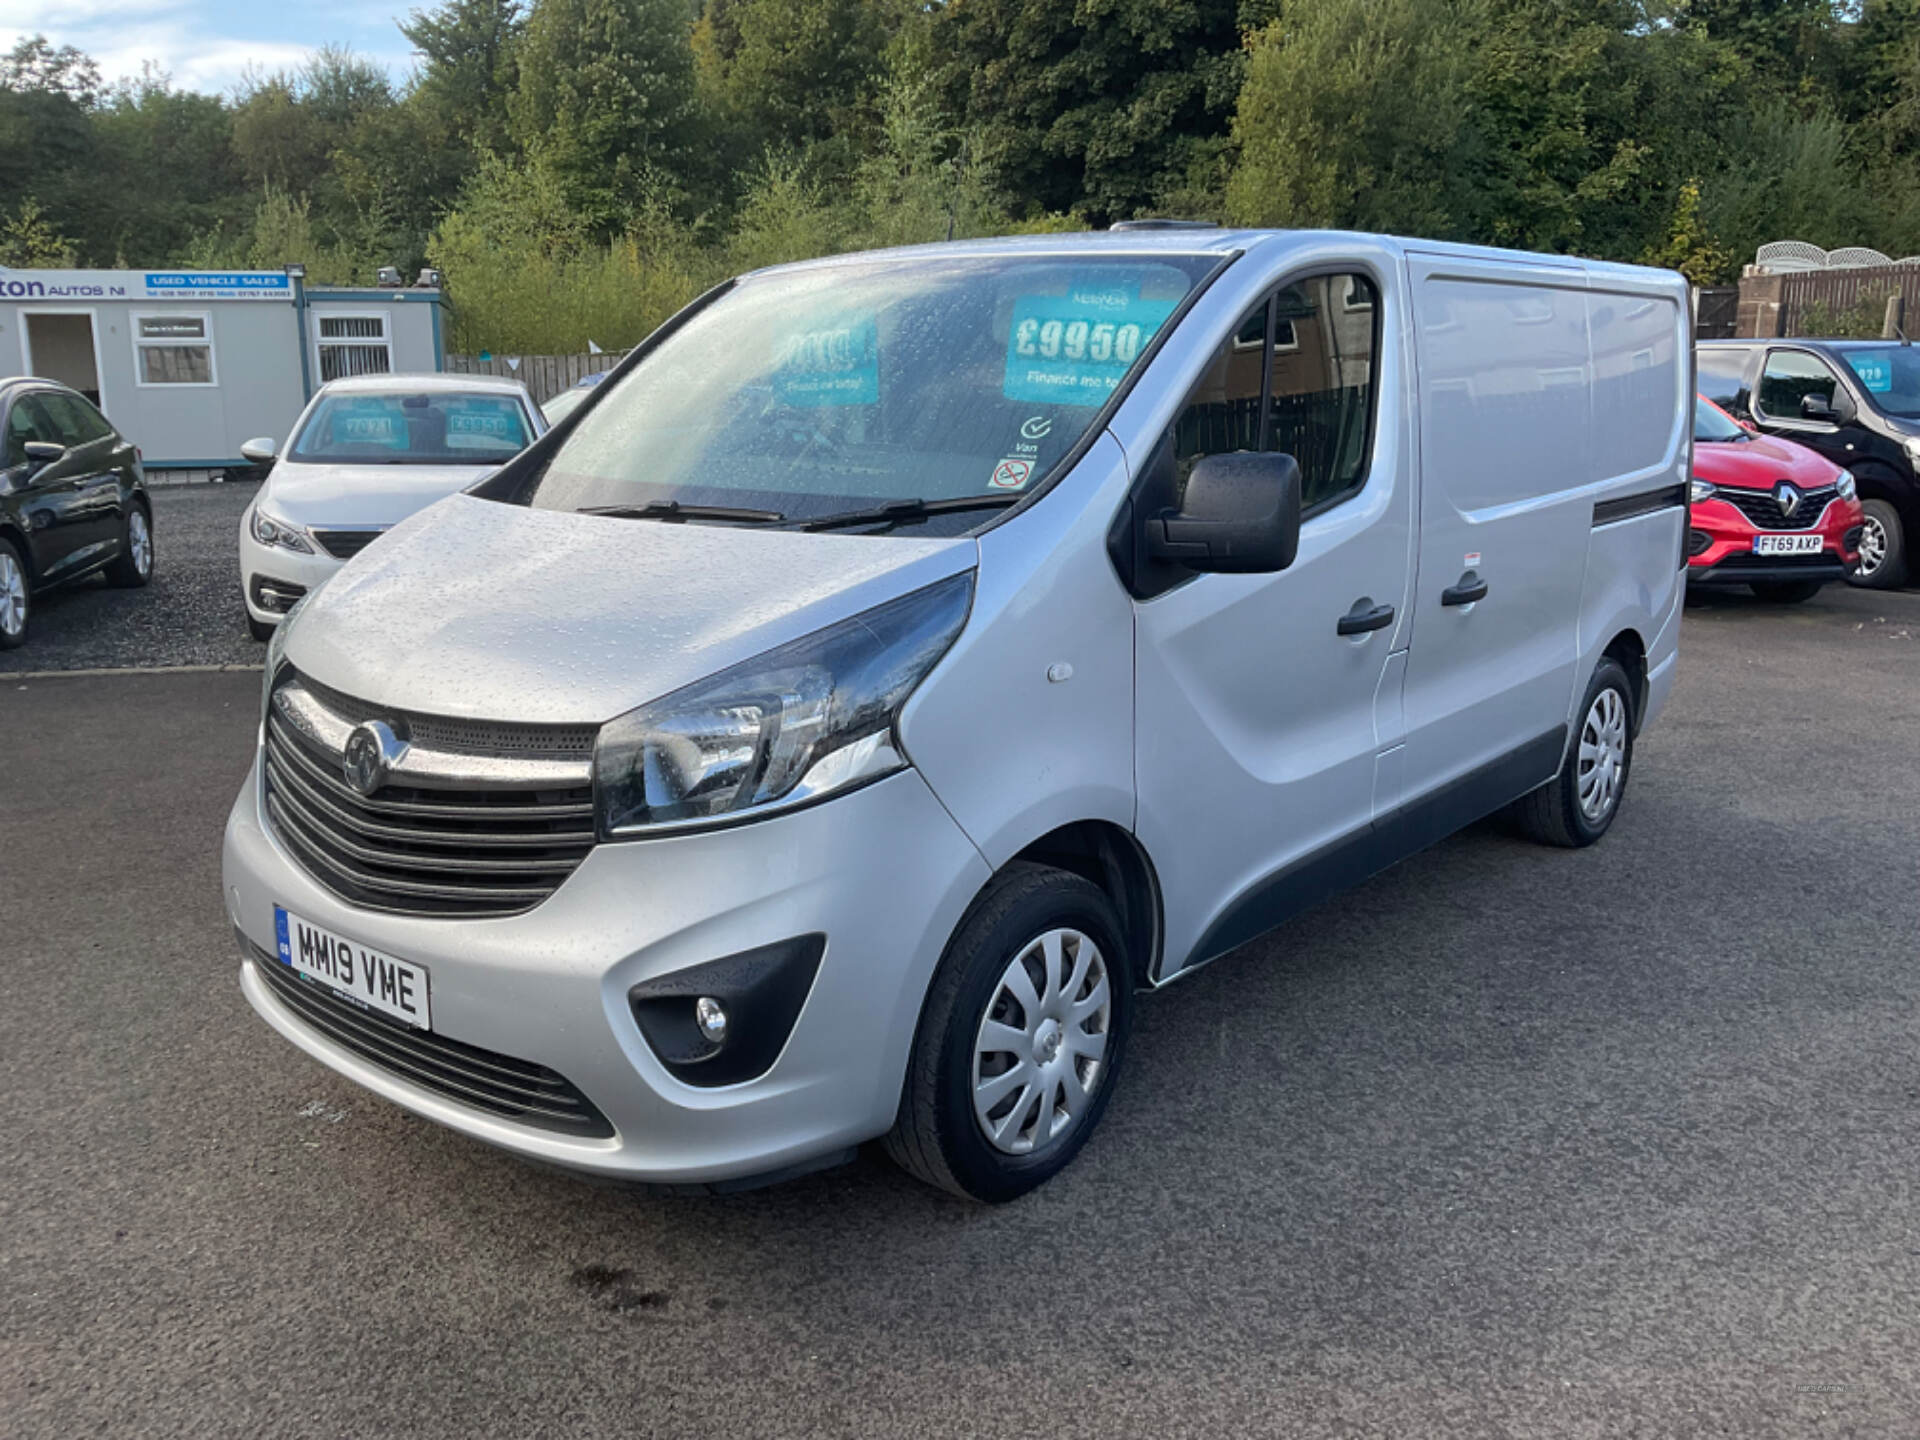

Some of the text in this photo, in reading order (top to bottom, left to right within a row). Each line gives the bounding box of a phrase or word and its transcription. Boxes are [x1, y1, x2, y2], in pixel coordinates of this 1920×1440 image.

[153, 276, 279, 286] USED VEHICLE SALES
[48, 285, 103, 296] AUTOS
[110, 286, 125, 296] NI
[1016, 319, 1140, 362] £9950
[1026, 370, 1077, 386] Finance
[1080, 375, 1103, 388] me
[1761, 536, 1821, 551] FT69 AXP
[298, 923, 417, 1015] MM19 VME
